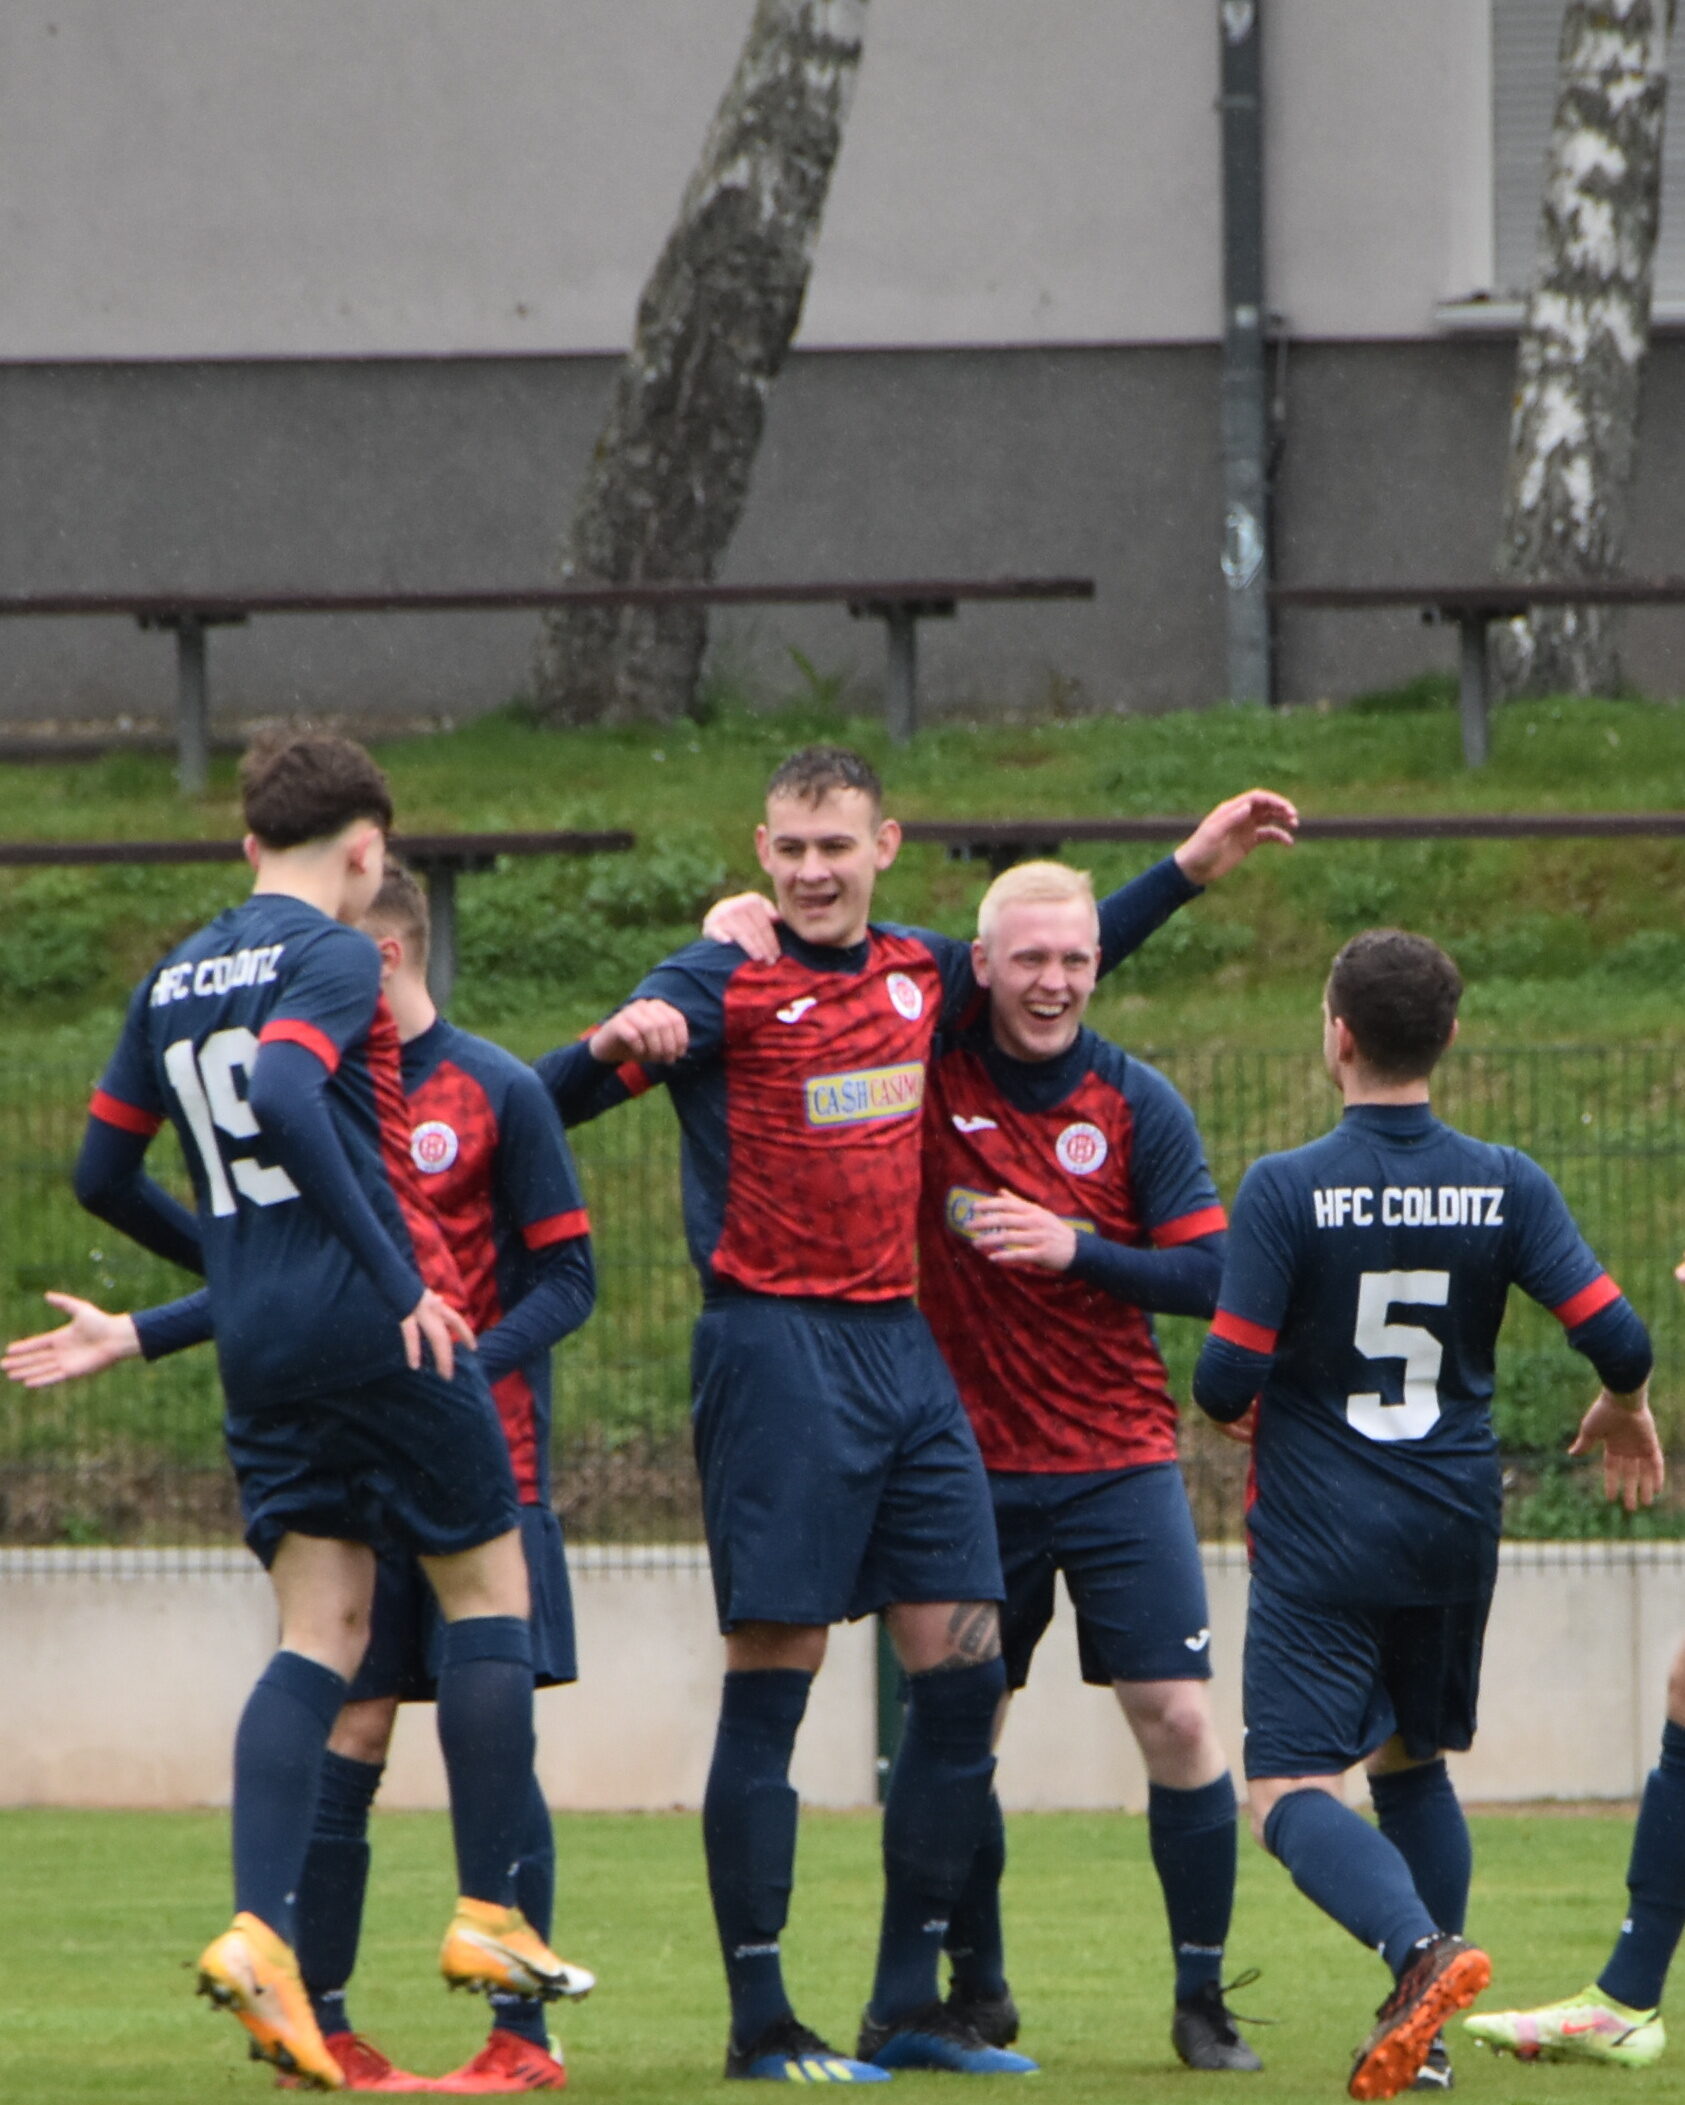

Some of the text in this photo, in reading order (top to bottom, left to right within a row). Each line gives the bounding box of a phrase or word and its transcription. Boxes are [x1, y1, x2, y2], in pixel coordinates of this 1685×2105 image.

[164, 1027, 300, 1217] 19
[1313, 1187, 1504, 1228] HFC COLDITZ
[1346, 1270, 1450, 1441] 5
